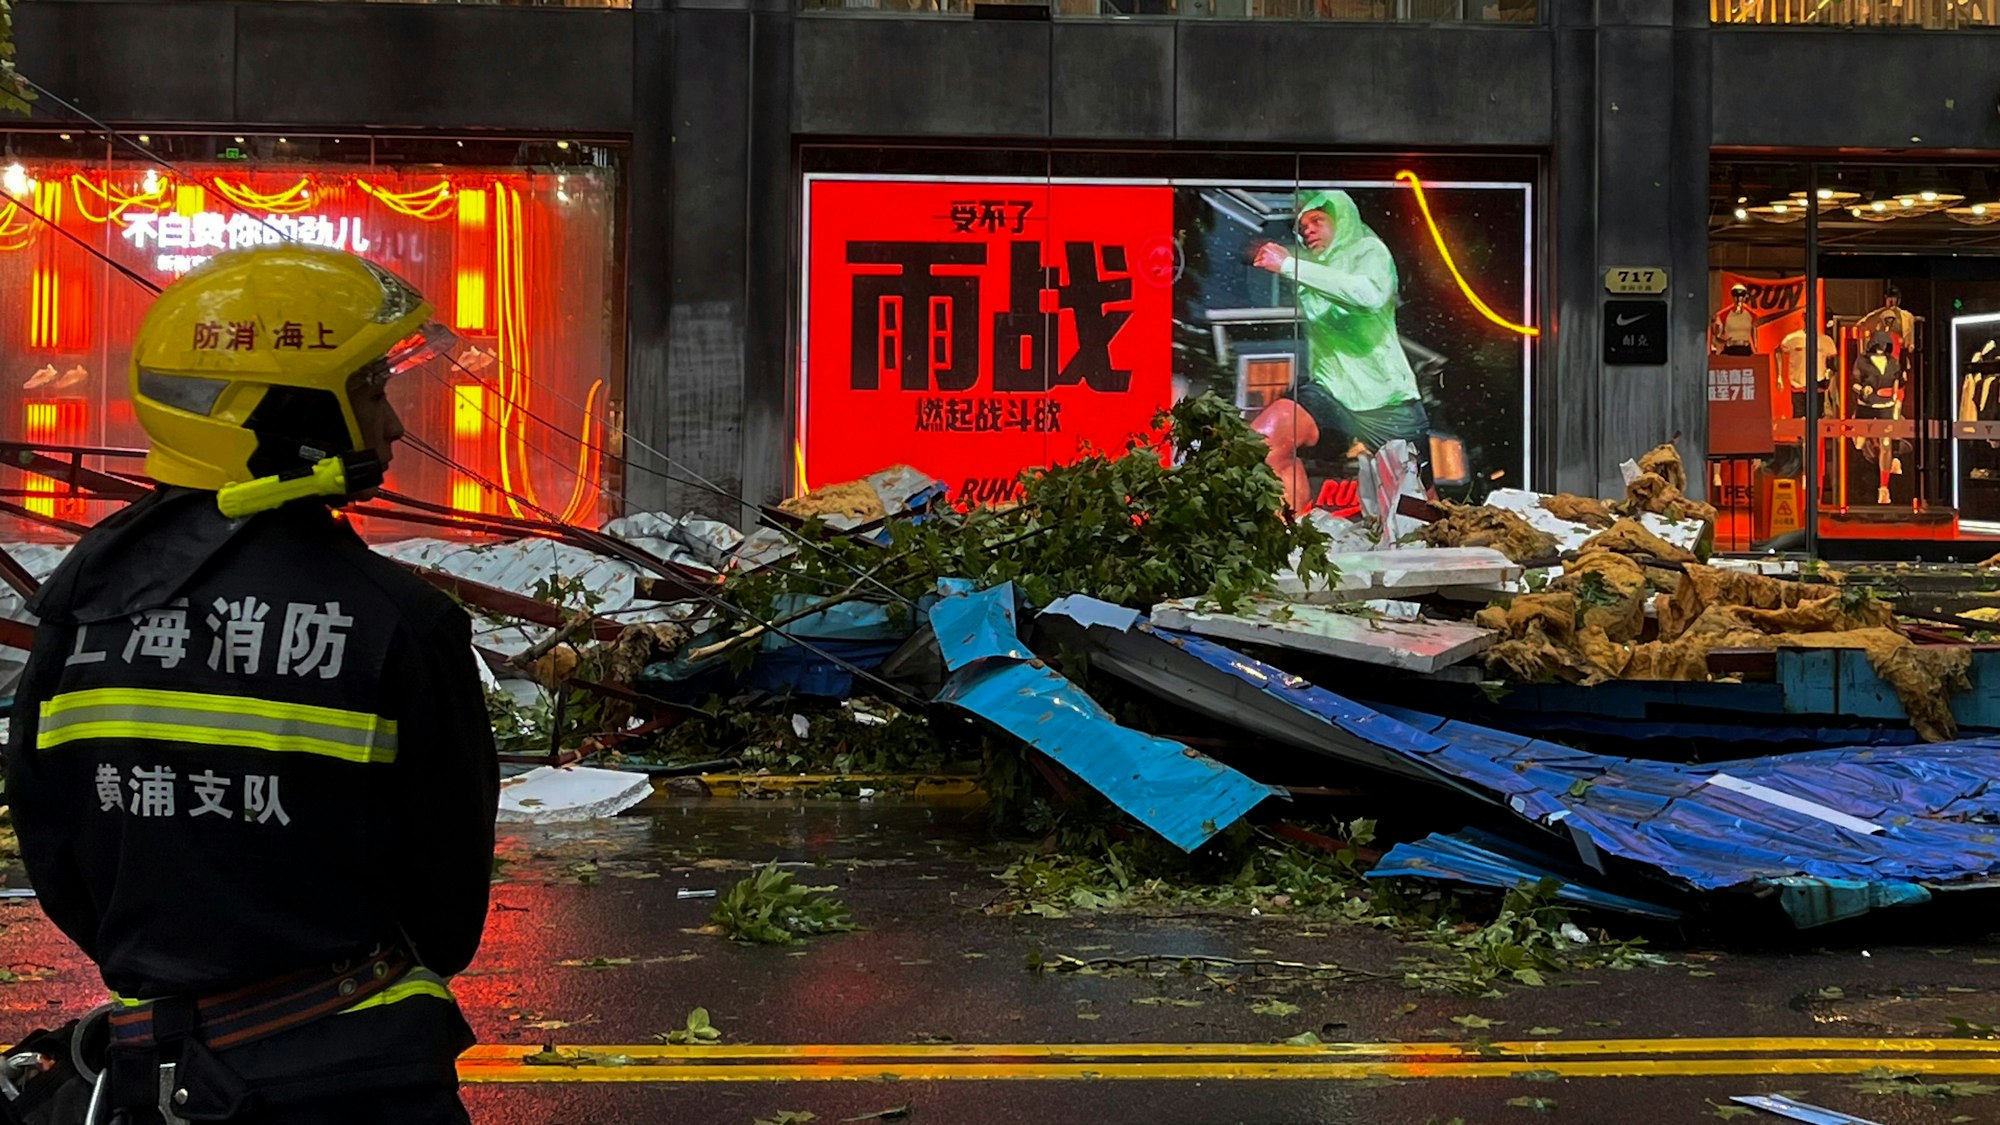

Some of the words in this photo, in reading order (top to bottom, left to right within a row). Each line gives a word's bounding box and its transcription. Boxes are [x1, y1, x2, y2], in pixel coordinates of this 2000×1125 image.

[122, 211, 370, 251] 不白费你的劲儿
[1617, 271, 1655, 283] 717
[1746, 280, 1804, 311] RUN
[846, 240, 1134, 393] 雨战
[915, 398, 1063, 432] 燃起战斗欲
[959, 478, 1017, 503] RUN
[1316, 479, 1361, 506] RU
[94, 763, 291, 826] 黄浦支队
